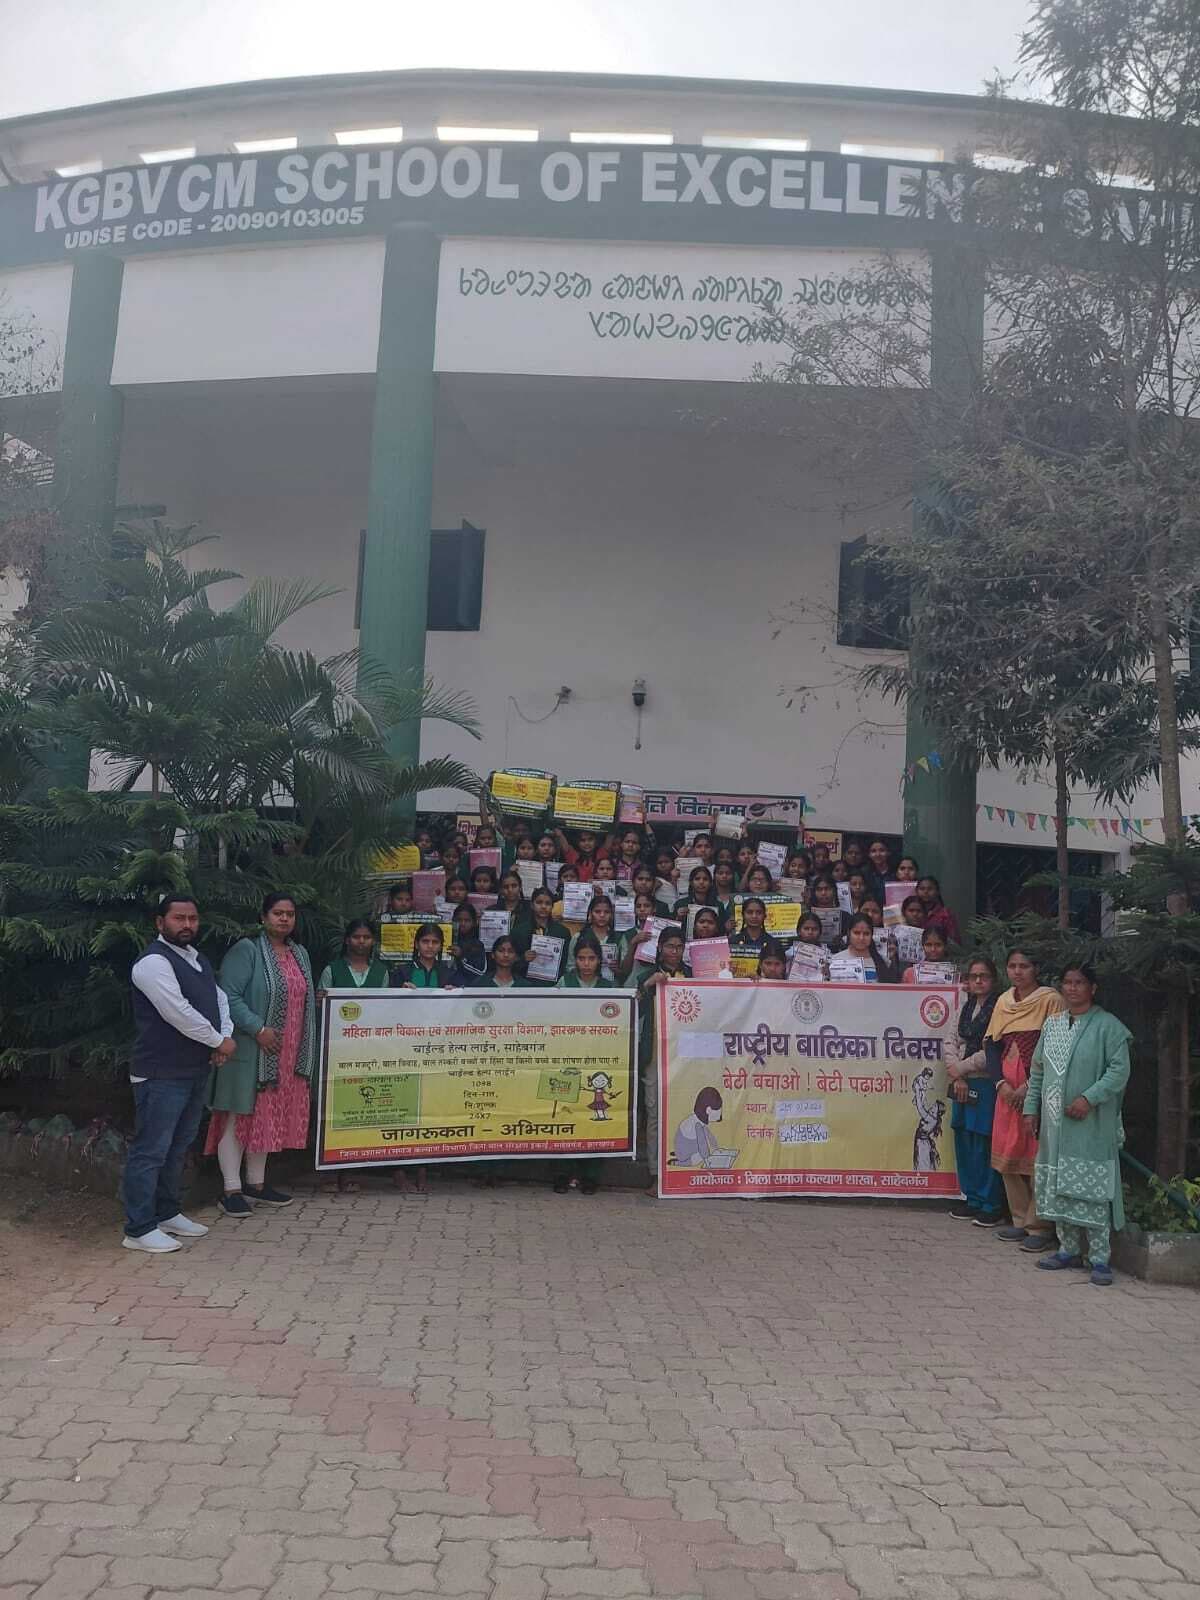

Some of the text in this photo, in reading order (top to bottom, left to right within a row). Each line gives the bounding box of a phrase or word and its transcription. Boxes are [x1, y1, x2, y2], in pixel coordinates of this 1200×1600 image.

[34, 165, 173, 233] KGBV
[177, 158, 258, 211] CM
[275, 146, 519, 204] SCHOOL
[540, 148, 620, 201] OF
[64, 228, 126, 249] UDISE
[132, 218, 192, 241] CODE
[210, 207, 364, 232] 20090103005
[342, 1024, 372, 1038] महिला
[375, 1026, 393, 1037] बाल
[396, 1024, 425, 1037] विकास
[445, 1023, 485, 1037] सामाजिक
[488, 1024, 513, 1039] सुरक्षा
[589, 1026, 619, 1037] सरकार
[723, 1023, 943, 1065] राष्ट्रीय बालिका दिवस
[723, 1067, 747, 1090] बेटी
[754, 1071, 801, 1091] बचाओ
[817, 1069, 842, 1092] बेटी
[381, 1125, 475, 1141] जागरूकता
[500, 1119, 575, 1136] अभियान
[744, 1124, 774, 1139] दिनांक
[689, 1172, 734, 1188] आयोजक
[745, 1171, 771, 1187] जिला
[773, 1174, 803, 1186] समाज
[805, 1174, 842, 1187] कल्याण
[881, 1171, 928, 1188] साहेबगंज
